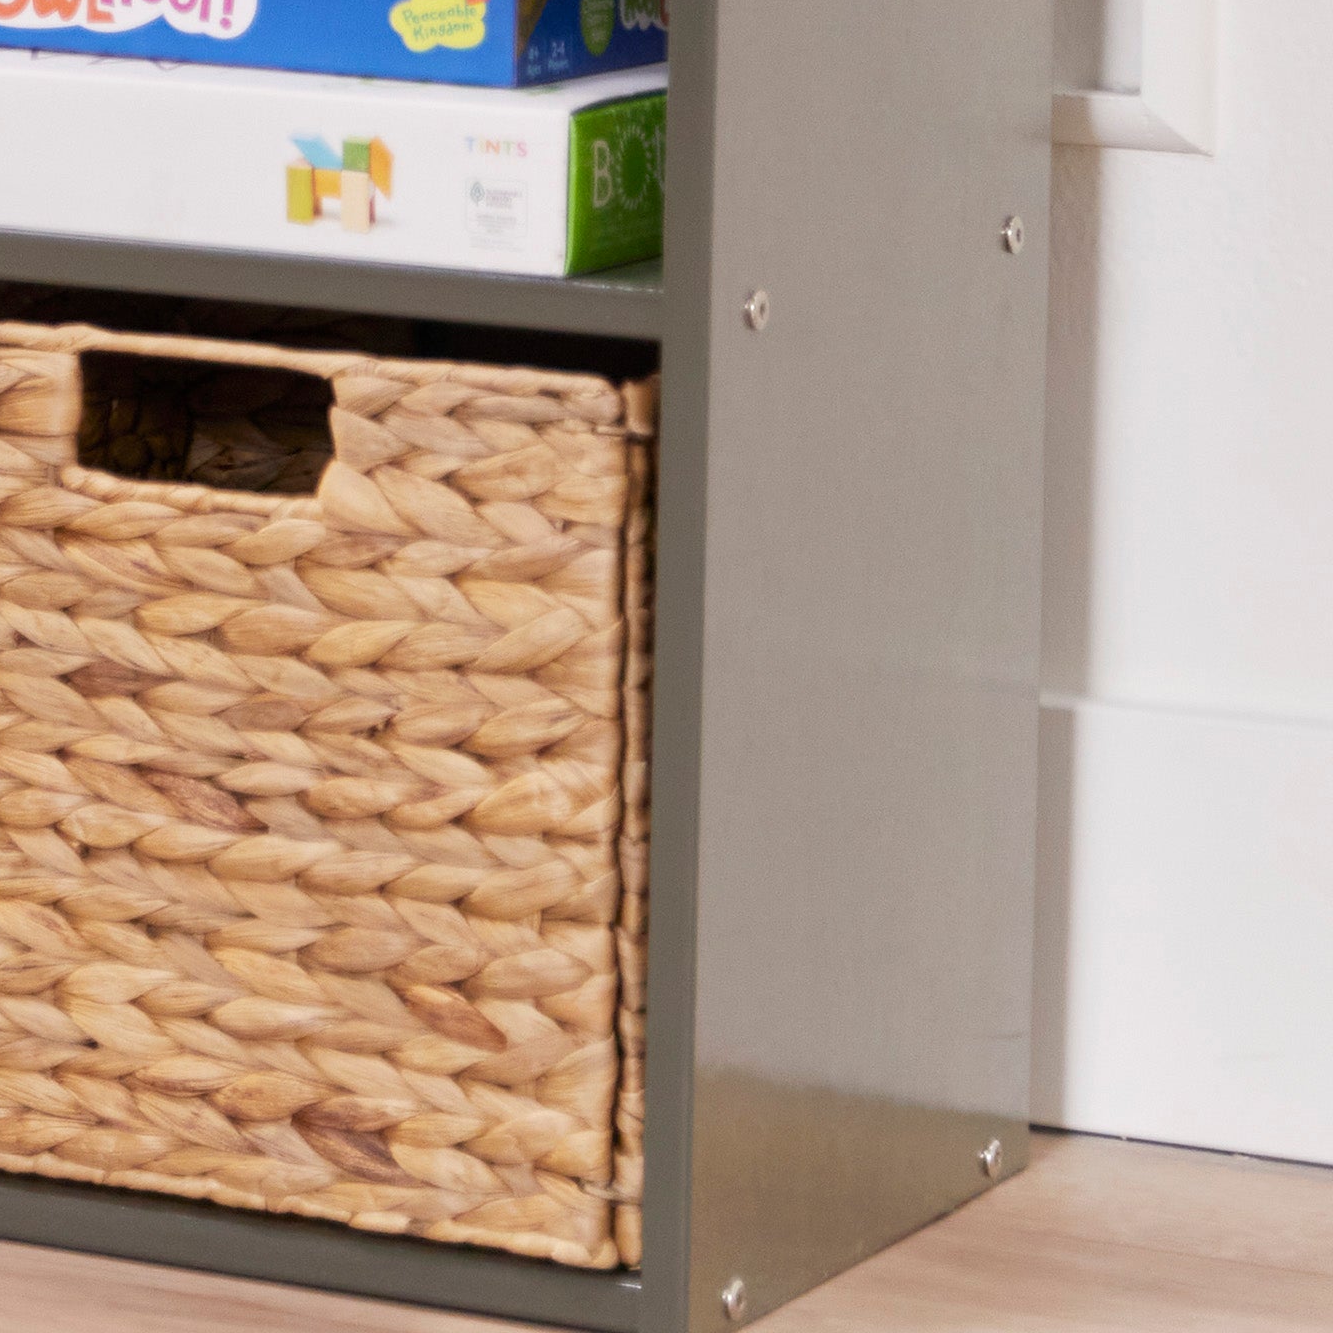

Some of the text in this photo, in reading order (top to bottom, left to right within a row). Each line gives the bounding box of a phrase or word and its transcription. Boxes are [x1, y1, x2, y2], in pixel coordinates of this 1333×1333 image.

[402, 4, 477, 24] Peaceable
[413, 22, 473, 42] Kingdom
[464, 135, 527, 158] TINTS
